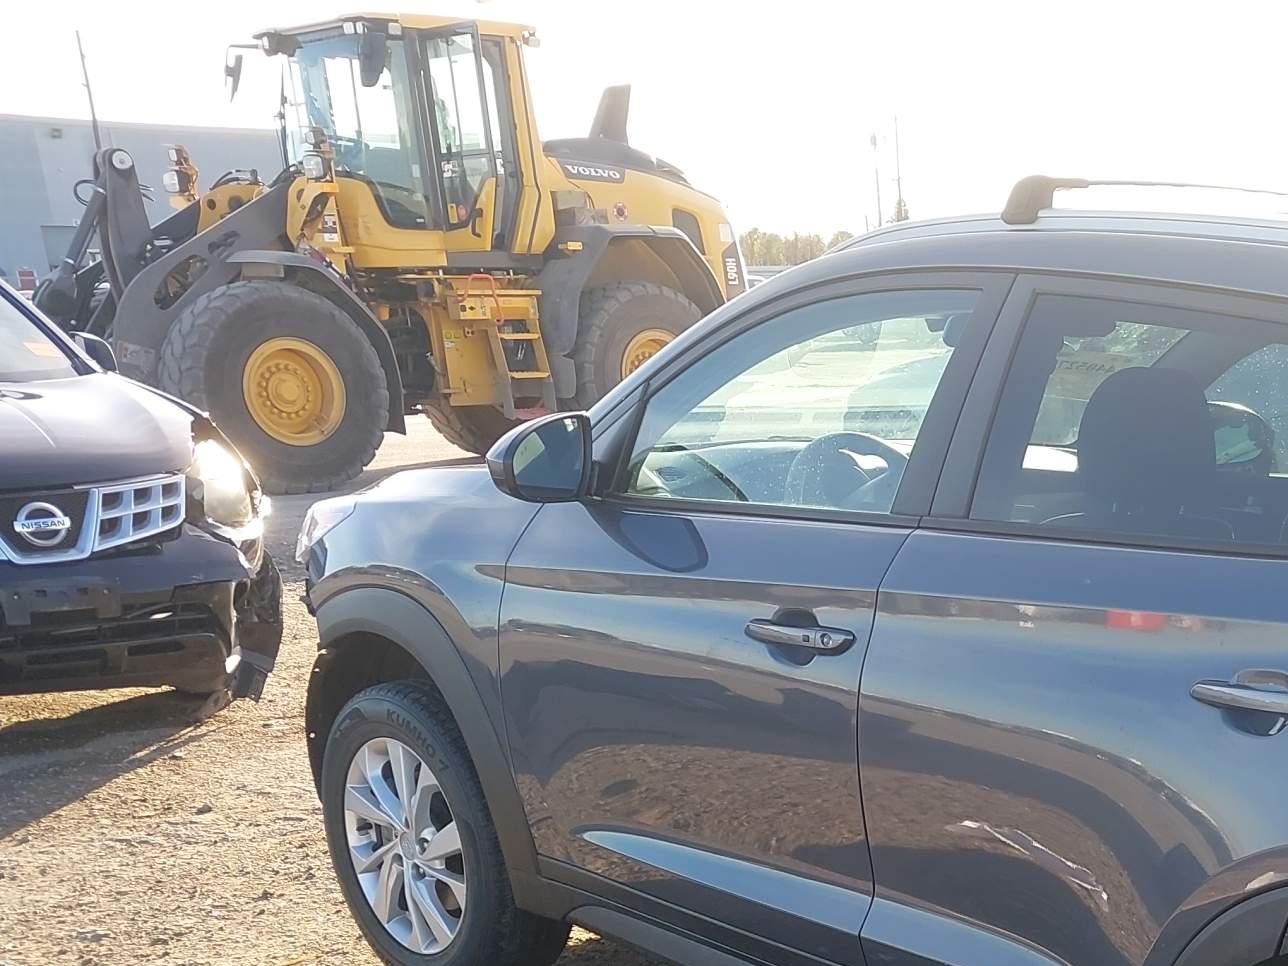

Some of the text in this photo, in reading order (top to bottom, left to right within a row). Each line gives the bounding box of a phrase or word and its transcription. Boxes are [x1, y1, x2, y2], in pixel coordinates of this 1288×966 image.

[564, 165, 621, 179] VOLVO
[725, 258, 739, 285] L90H
[21, 520, 65, 530] NISSAN
[386, 708, 436, 758] KUMHO
